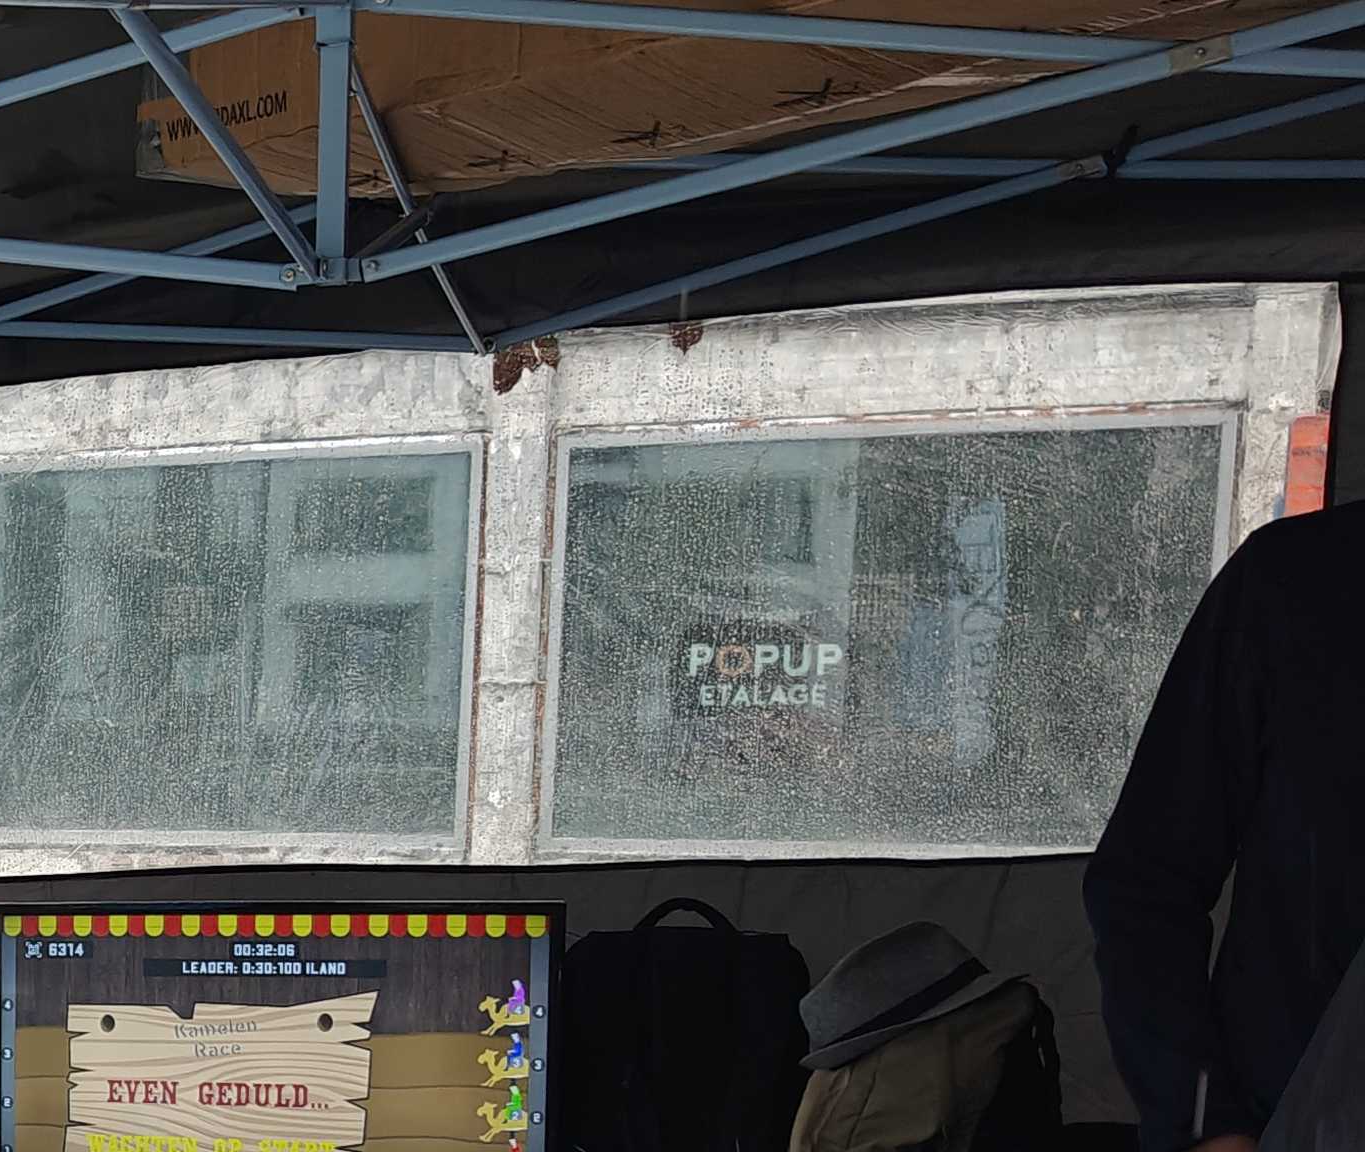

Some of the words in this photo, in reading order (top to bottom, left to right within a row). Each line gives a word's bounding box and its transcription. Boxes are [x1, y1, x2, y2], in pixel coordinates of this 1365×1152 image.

[166, 90, 287, 141] WWDAXL.COM
[689, 643, 843, 678] POPUP
[699, 683, 827, 706] ETALAGE
[49, 943, 84, 957] 6314
[233, 943, 295, 957] 00:32:06
[181, 961, 238, 975] LEADER:
[174, 1017, 258, 1039] Kamelen
[194, 1042, 242, 1058] Race
[107, 1080, 179, 1105] EVEN
